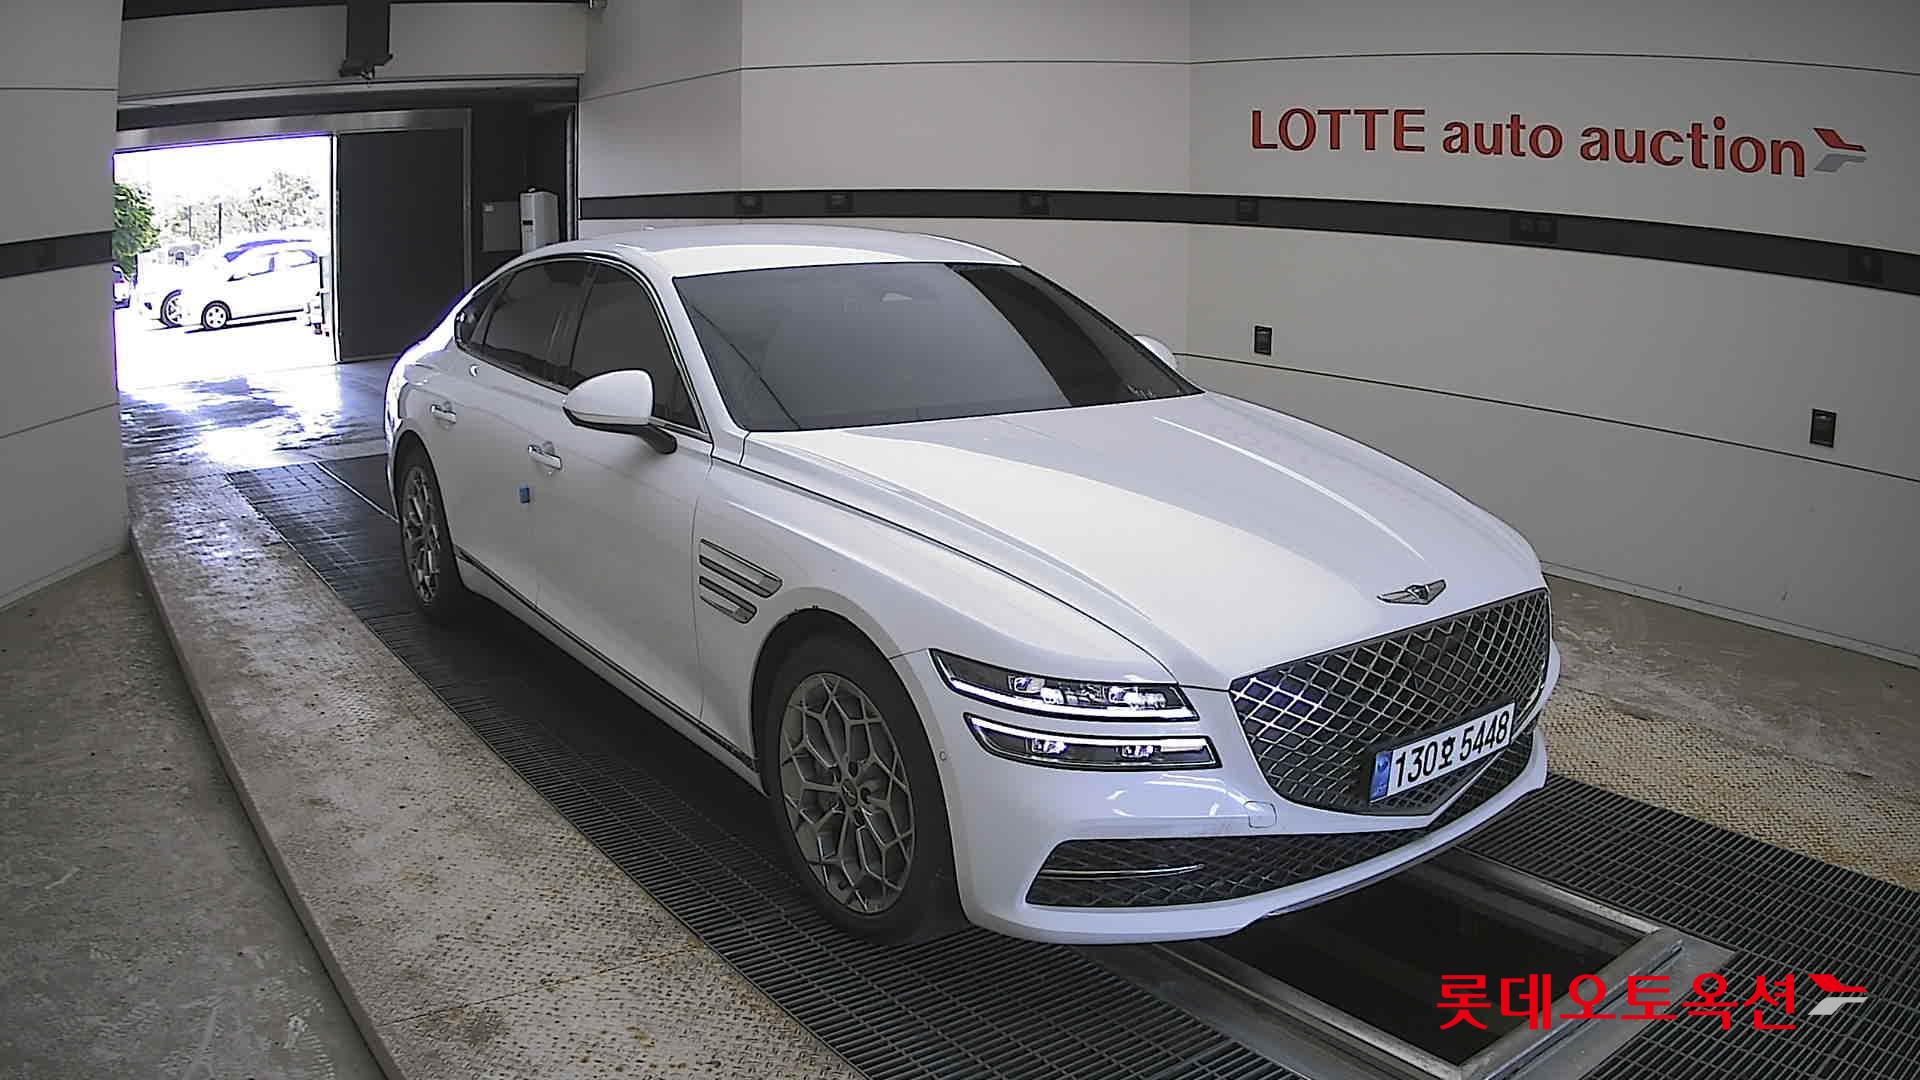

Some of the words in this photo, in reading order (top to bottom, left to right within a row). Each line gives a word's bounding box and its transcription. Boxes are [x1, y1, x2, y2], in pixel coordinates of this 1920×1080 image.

[1251, 108, 1426, 152] LOTTE
[1442, 114, 1563, 159] auto
[1579, 116, 1806, 178] auction
[1459, 710, 1510, 762] 5448
